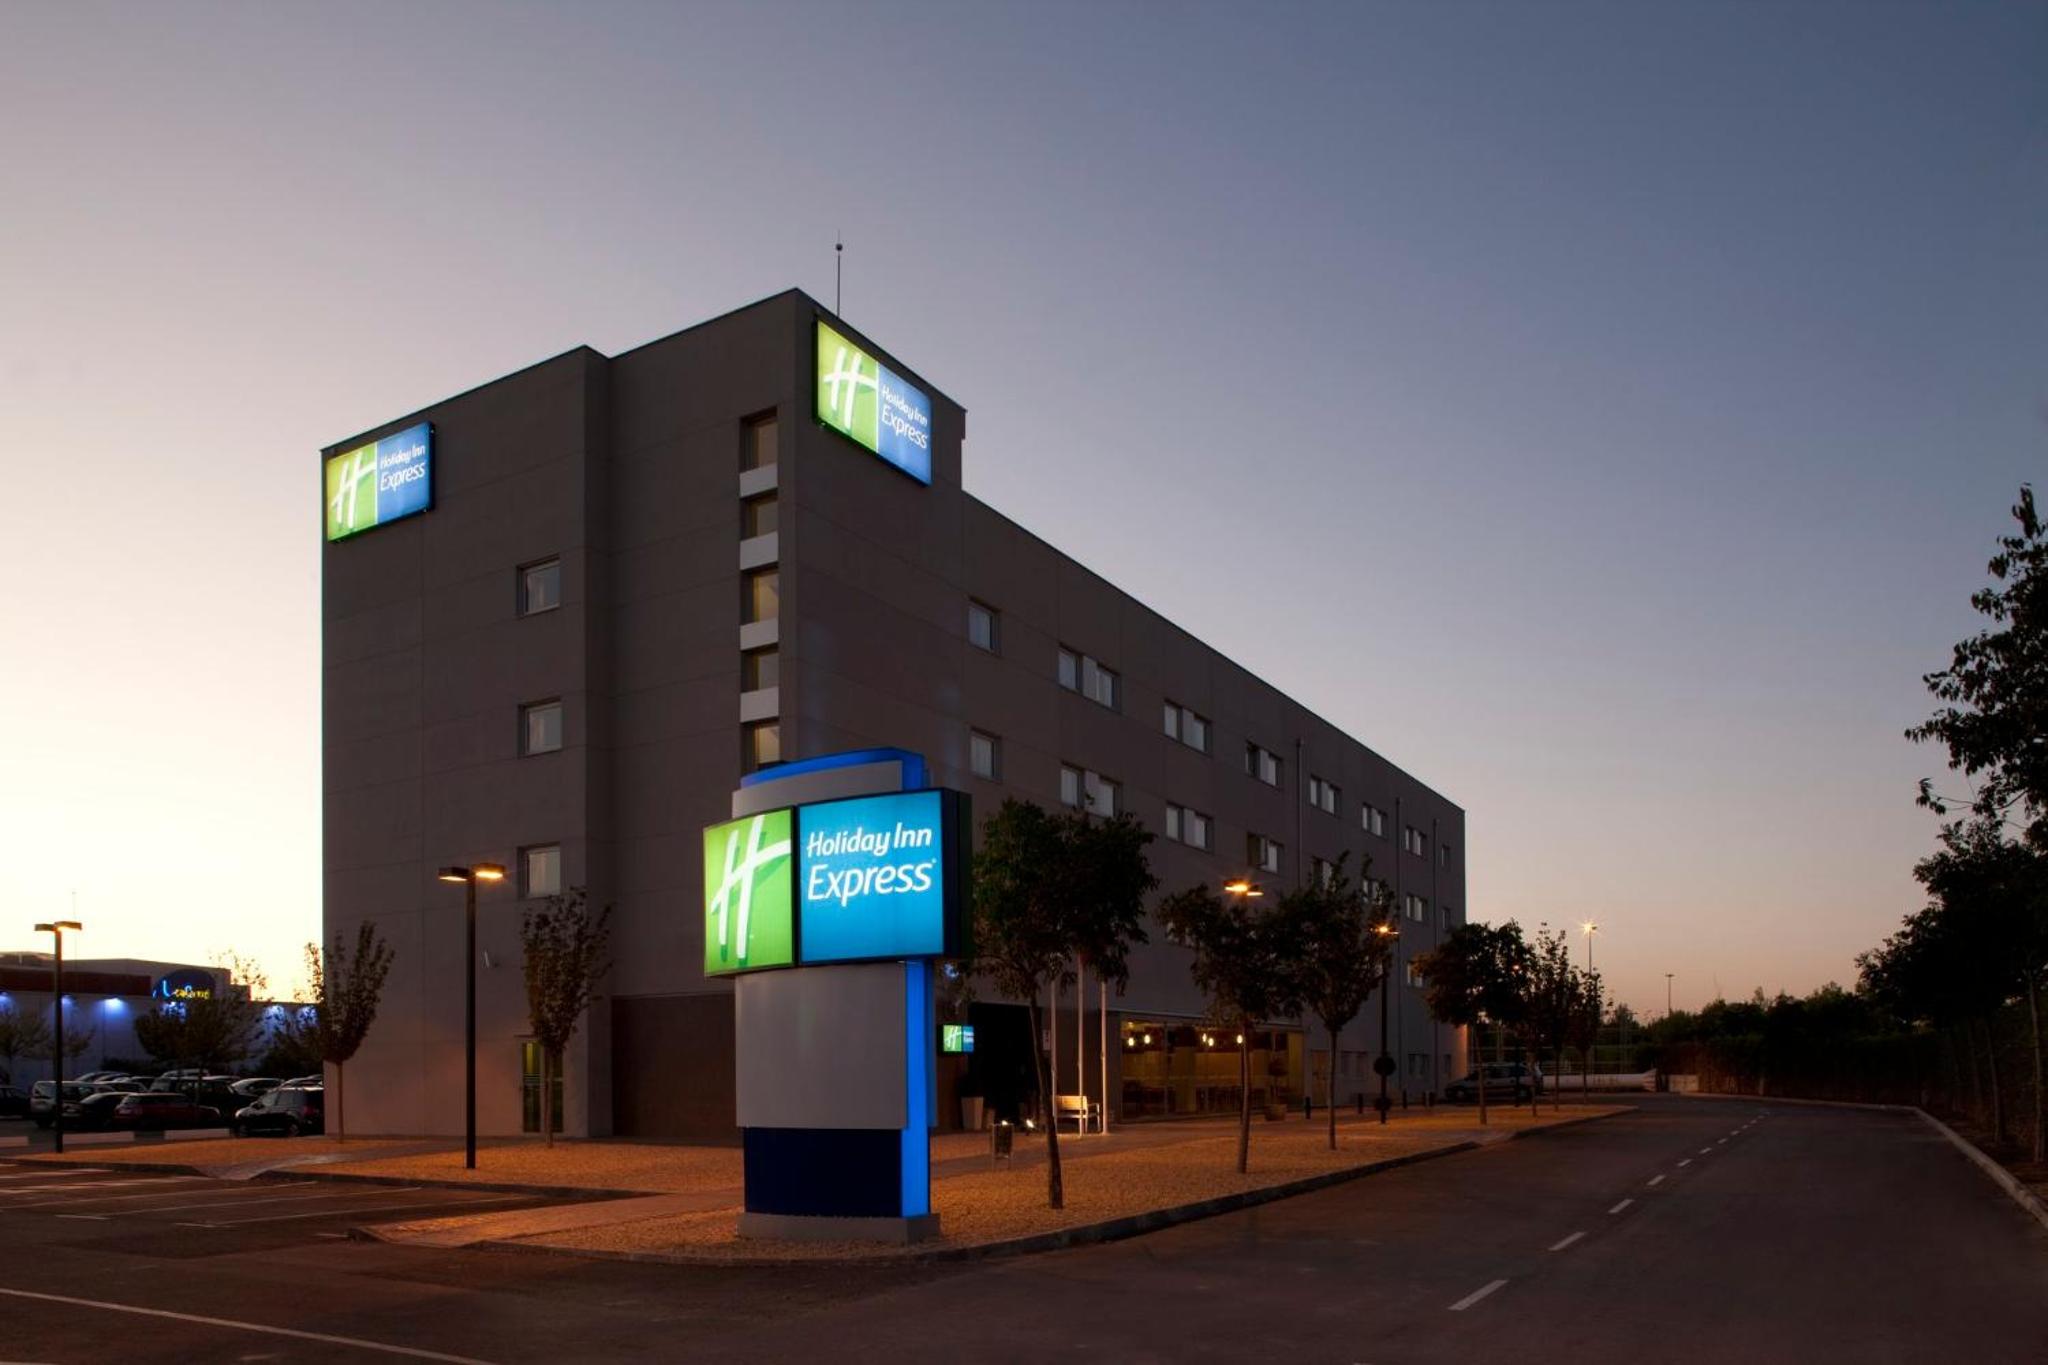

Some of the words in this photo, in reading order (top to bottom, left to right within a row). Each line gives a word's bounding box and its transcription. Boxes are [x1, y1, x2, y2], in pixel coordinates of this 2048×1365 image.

[882, 384, 914, 420] Holiday
[914, 407, 928, 426] Inn
[882, 405, 928, 449] Express
[380, 449, 411, 470] Holiday
[411, 444, 425, 458] Inn
[380, 462, 425, 491] Express
[806, 826, 890, 858] Holiday
[893, 822, 932, 849] Inn
[806, 862, 933, 907] Express
